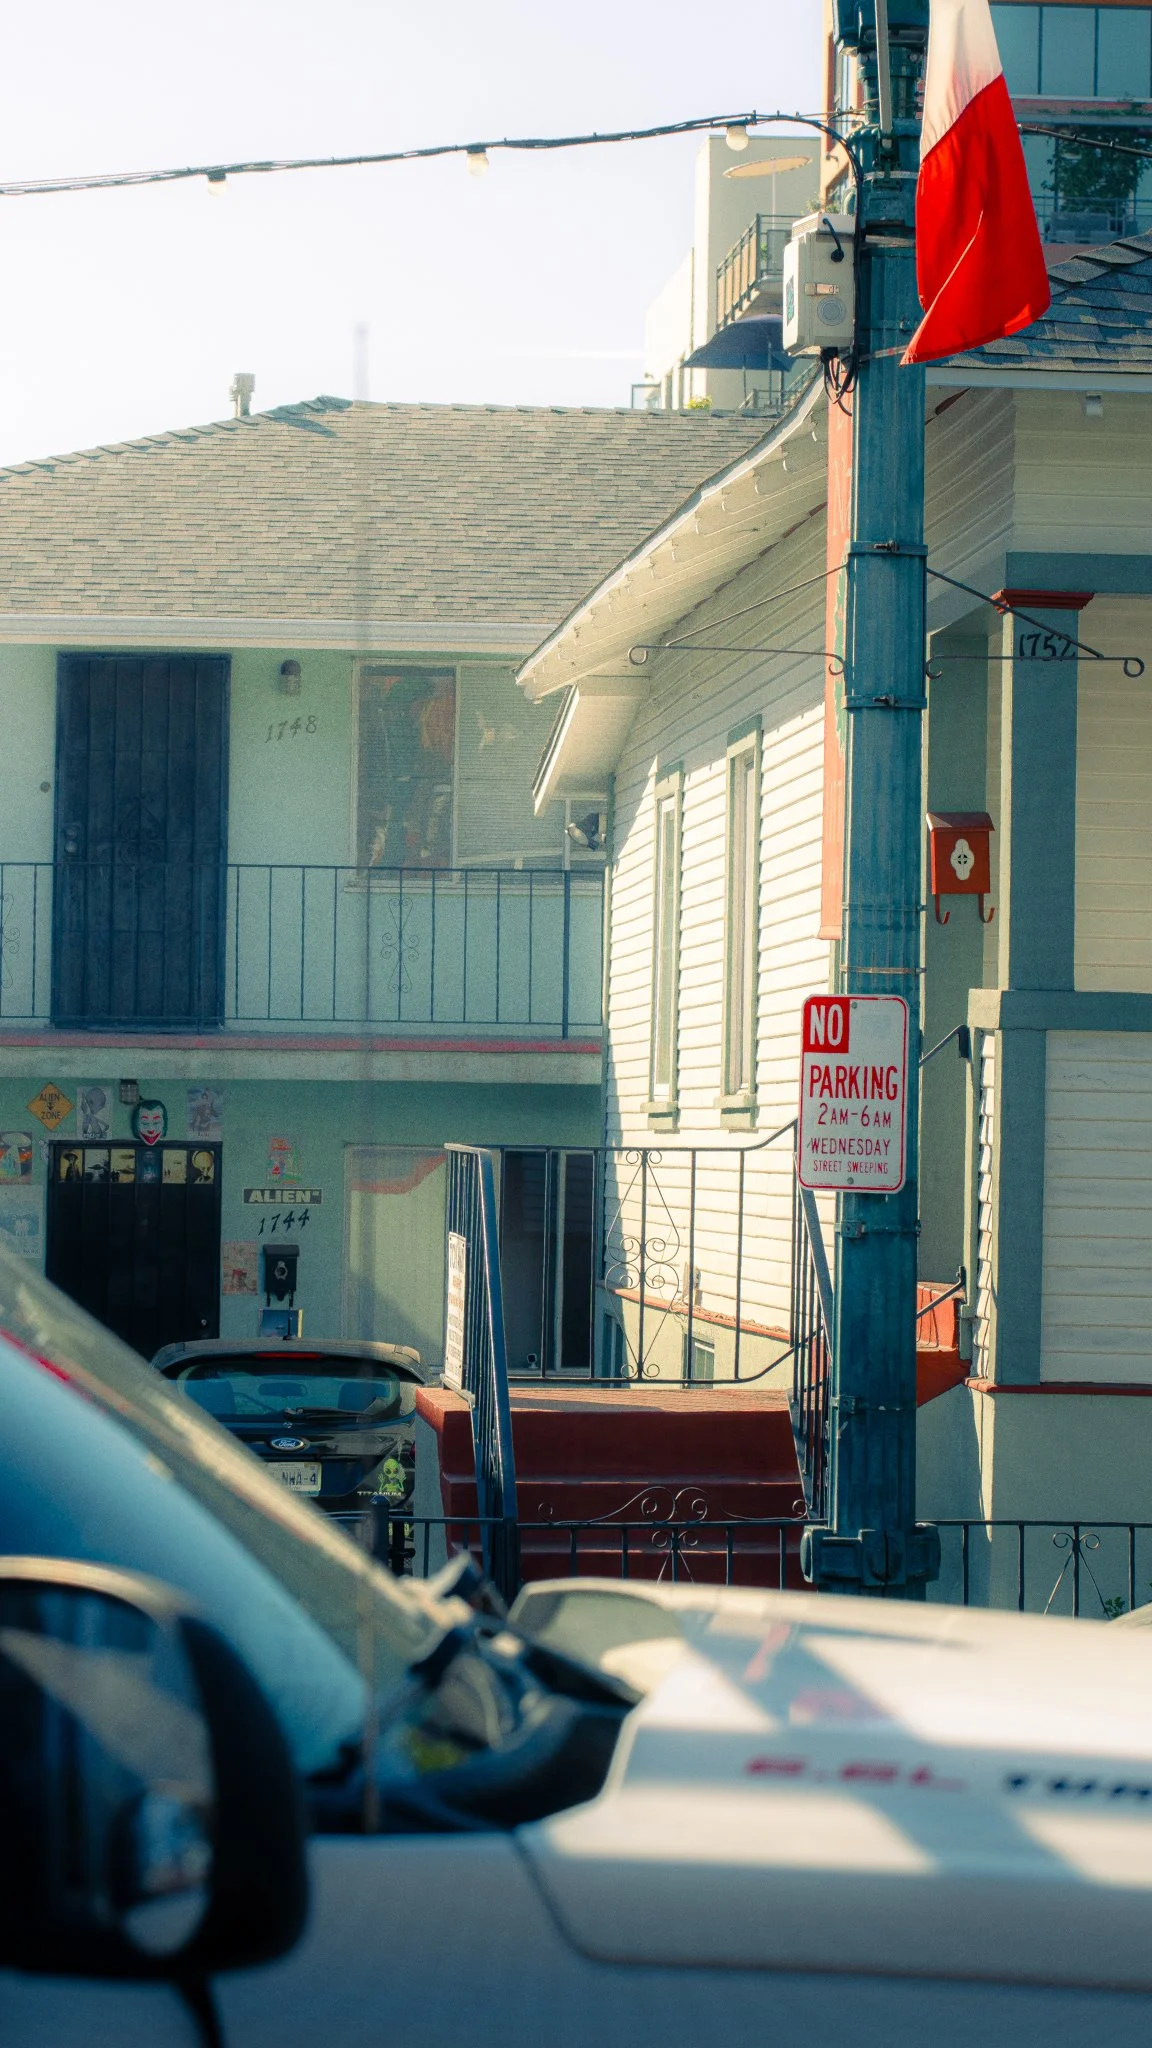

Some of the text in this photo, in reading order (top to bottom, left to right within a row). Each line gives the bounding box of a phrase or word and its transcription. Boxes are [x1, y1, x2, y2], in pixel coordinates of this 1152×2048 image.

[1019, 633, 1076, 661] 1752
[265, 715, 317, 744] 1748
[809, 1003, 843, 1046] NO
[809, 1065, 898, 1101] PARKING
[40, 1093, 60, 1102] ALIEN
[41, 1111, 61, 1120] ZONE
[809, 1138, 891, 1156] WEDNESDAY
[813, 1160, 889, 1175] STREET SWEEPING
[248, 1190, 311, 1203] ALIEN
[258, 1208, 310, 1236] 1744
[277, 1438, 297, 1448] Ford
